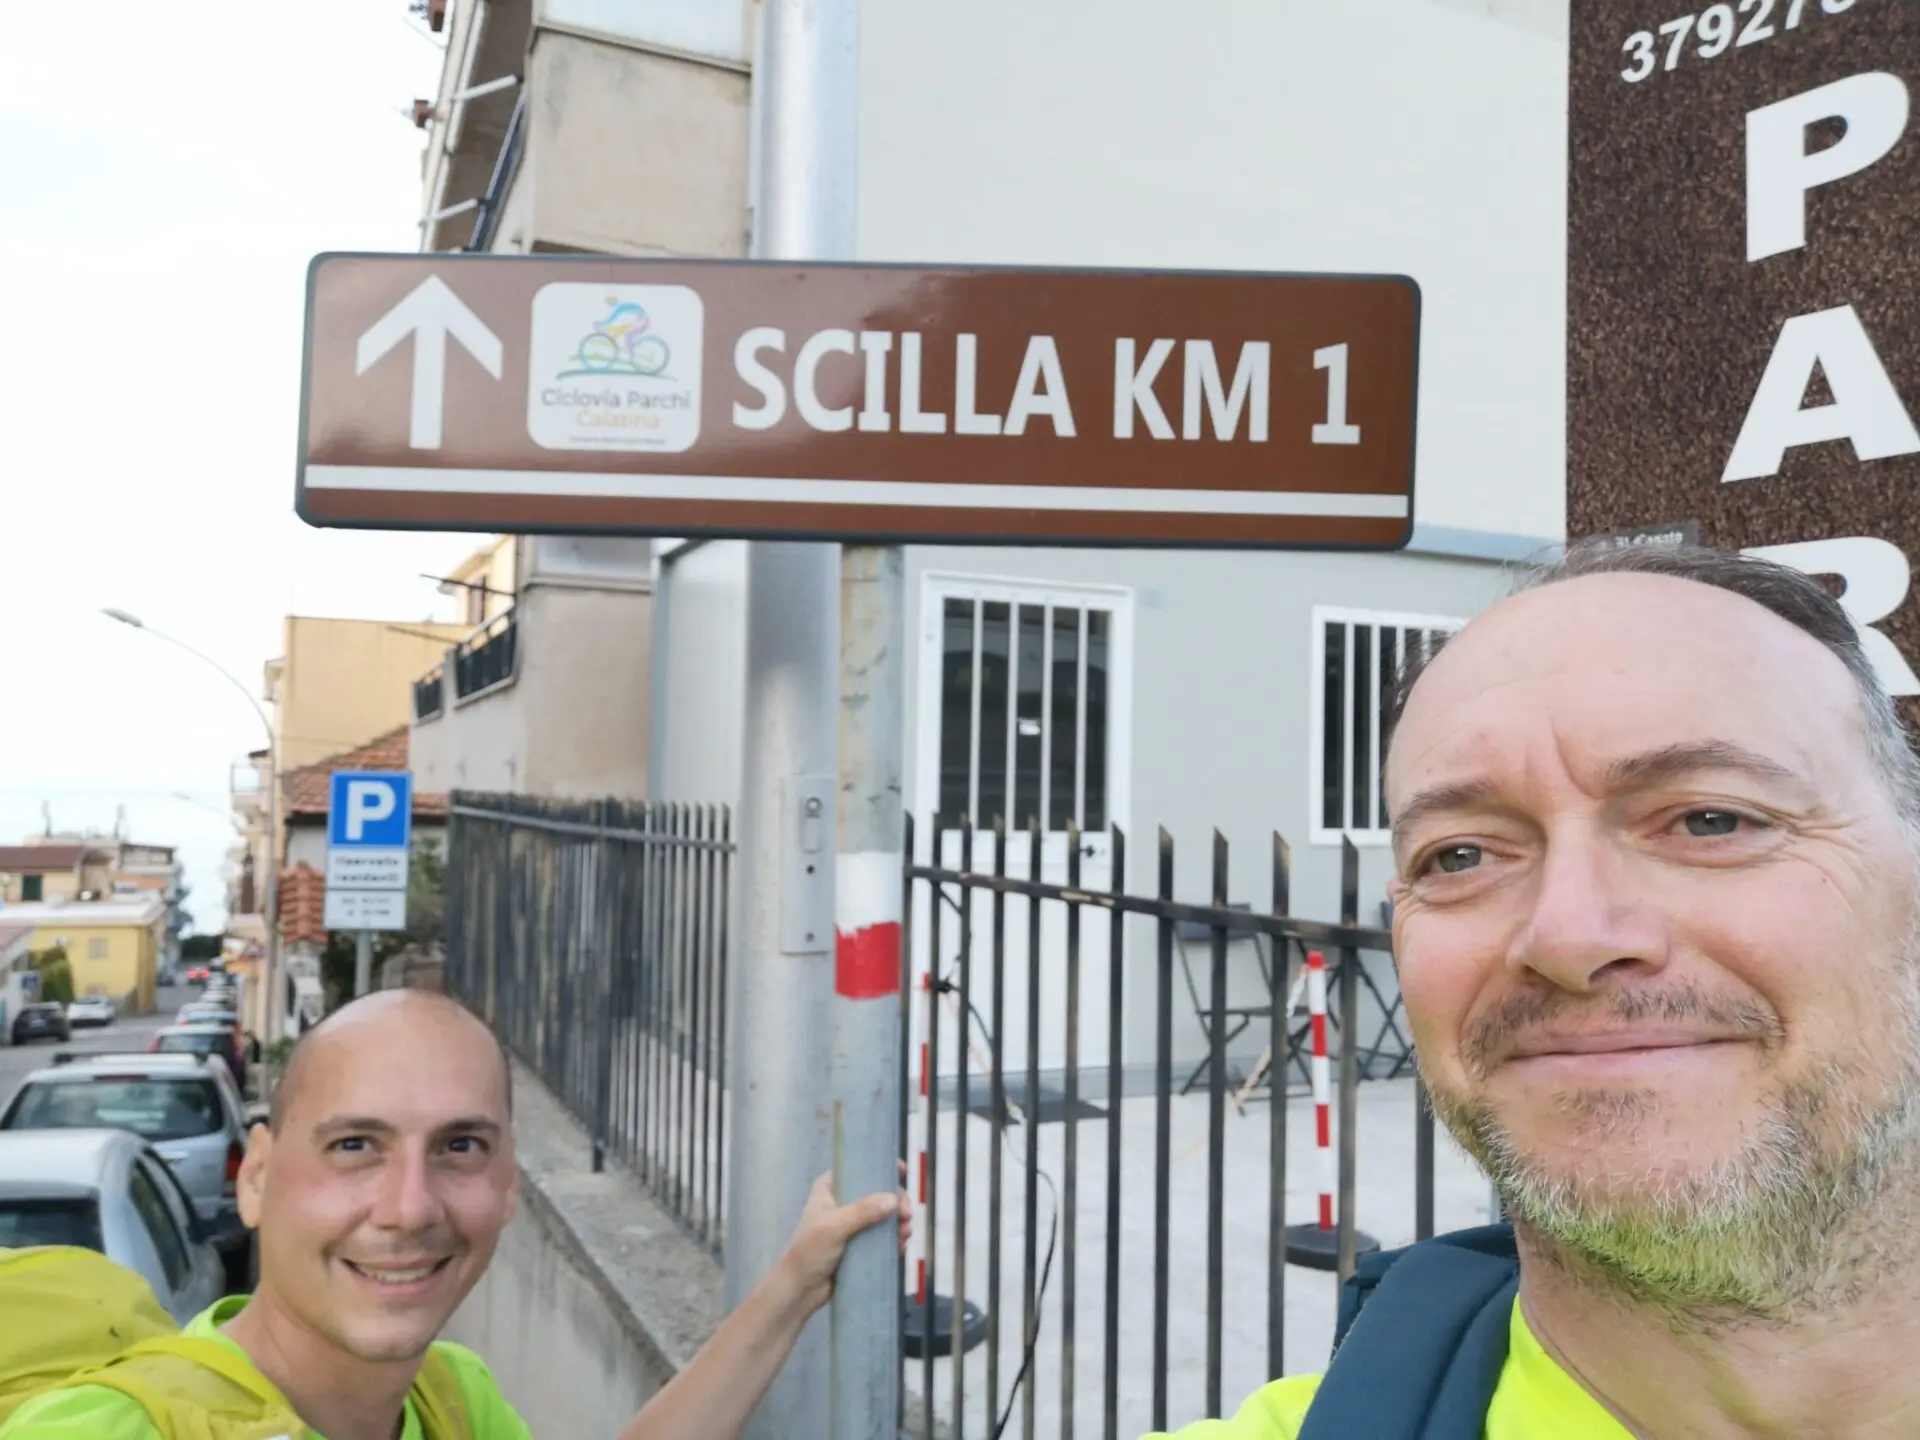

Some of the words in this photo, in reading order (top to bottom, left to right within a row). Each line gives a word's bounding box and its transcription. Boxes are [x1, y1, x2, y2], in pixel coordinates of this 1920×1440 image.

[1621, 0, 1857, 83] 37927
[541, 387, 620, 408] Ciclovia
[627, 390, 691, 410] Parchi
[732, 325, 1077, 438] SCILLA
[1113, 337, 1271, 442] KM
[1310, 342, 1361, 445] 1
[345, 779, 397, 841] P
